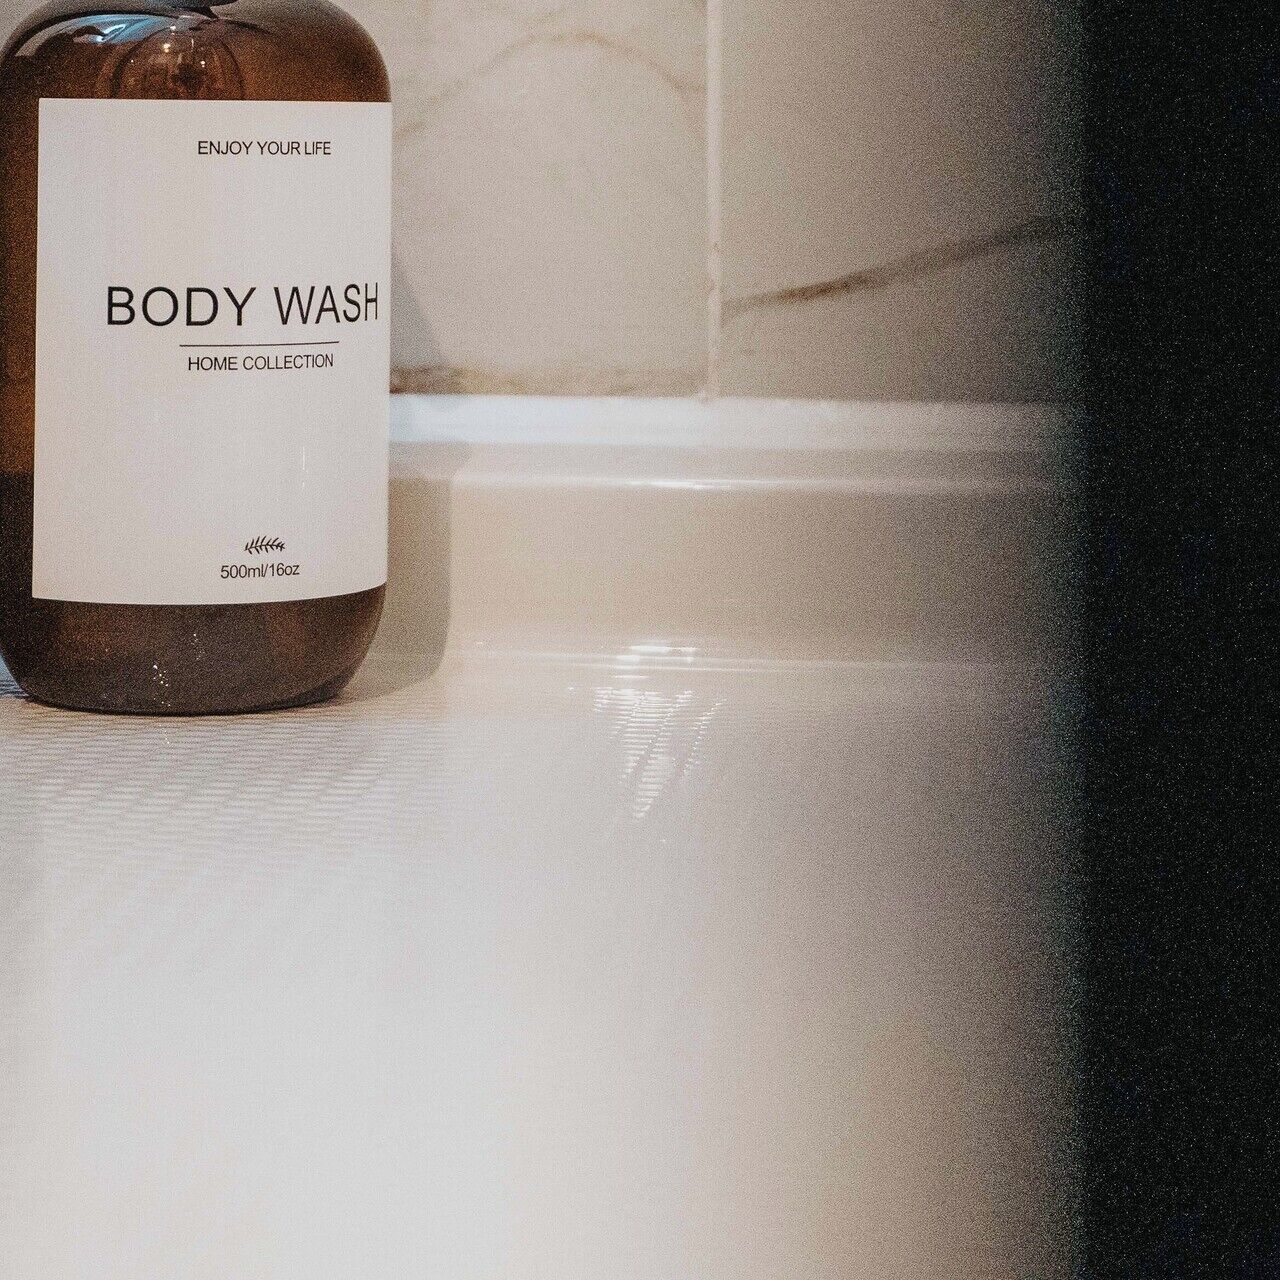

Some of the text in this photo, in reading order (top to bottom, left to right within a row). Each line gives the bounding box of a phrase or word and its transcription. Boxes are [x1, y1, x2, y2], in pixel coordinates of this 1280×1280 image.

[198, 141, 331, 155] ENJOY YOUR LIFE
[107, 283, 378, 327] BODY WASH
[188, 354, 333, 370] HOME COLLECTION
[221, 563, 299, 579] 500ml/16oz
